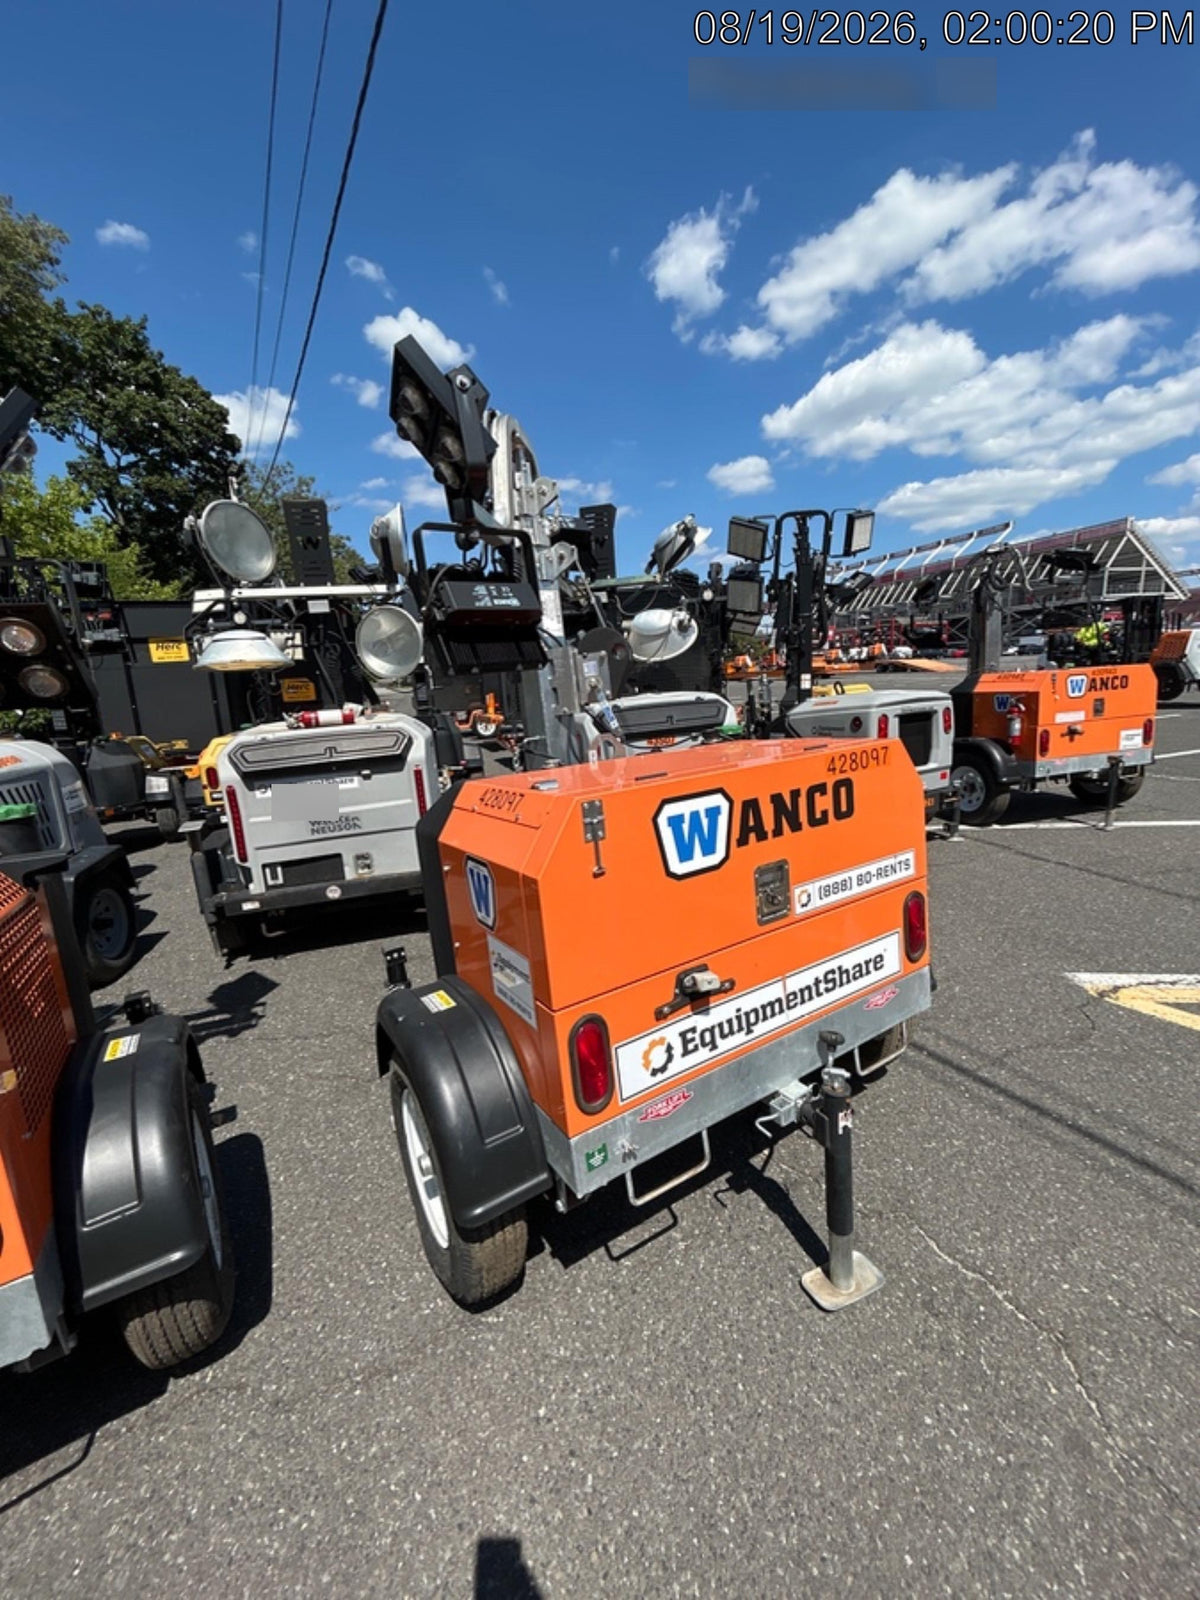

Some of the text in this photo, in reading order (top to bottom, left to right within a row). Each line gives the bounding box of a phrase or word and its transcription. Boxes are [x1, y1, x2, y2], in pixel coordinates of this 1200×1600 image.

[1068, 675, 1129, 695] WANCO
[827, 746, 889, 775] 428097
[479, 788, 525, 813] 428097
[666, 778, 855, 864] WANCO
[818, 879, 853, 901] (888)
[679, 952, 886, 1058] EquipmentShare
